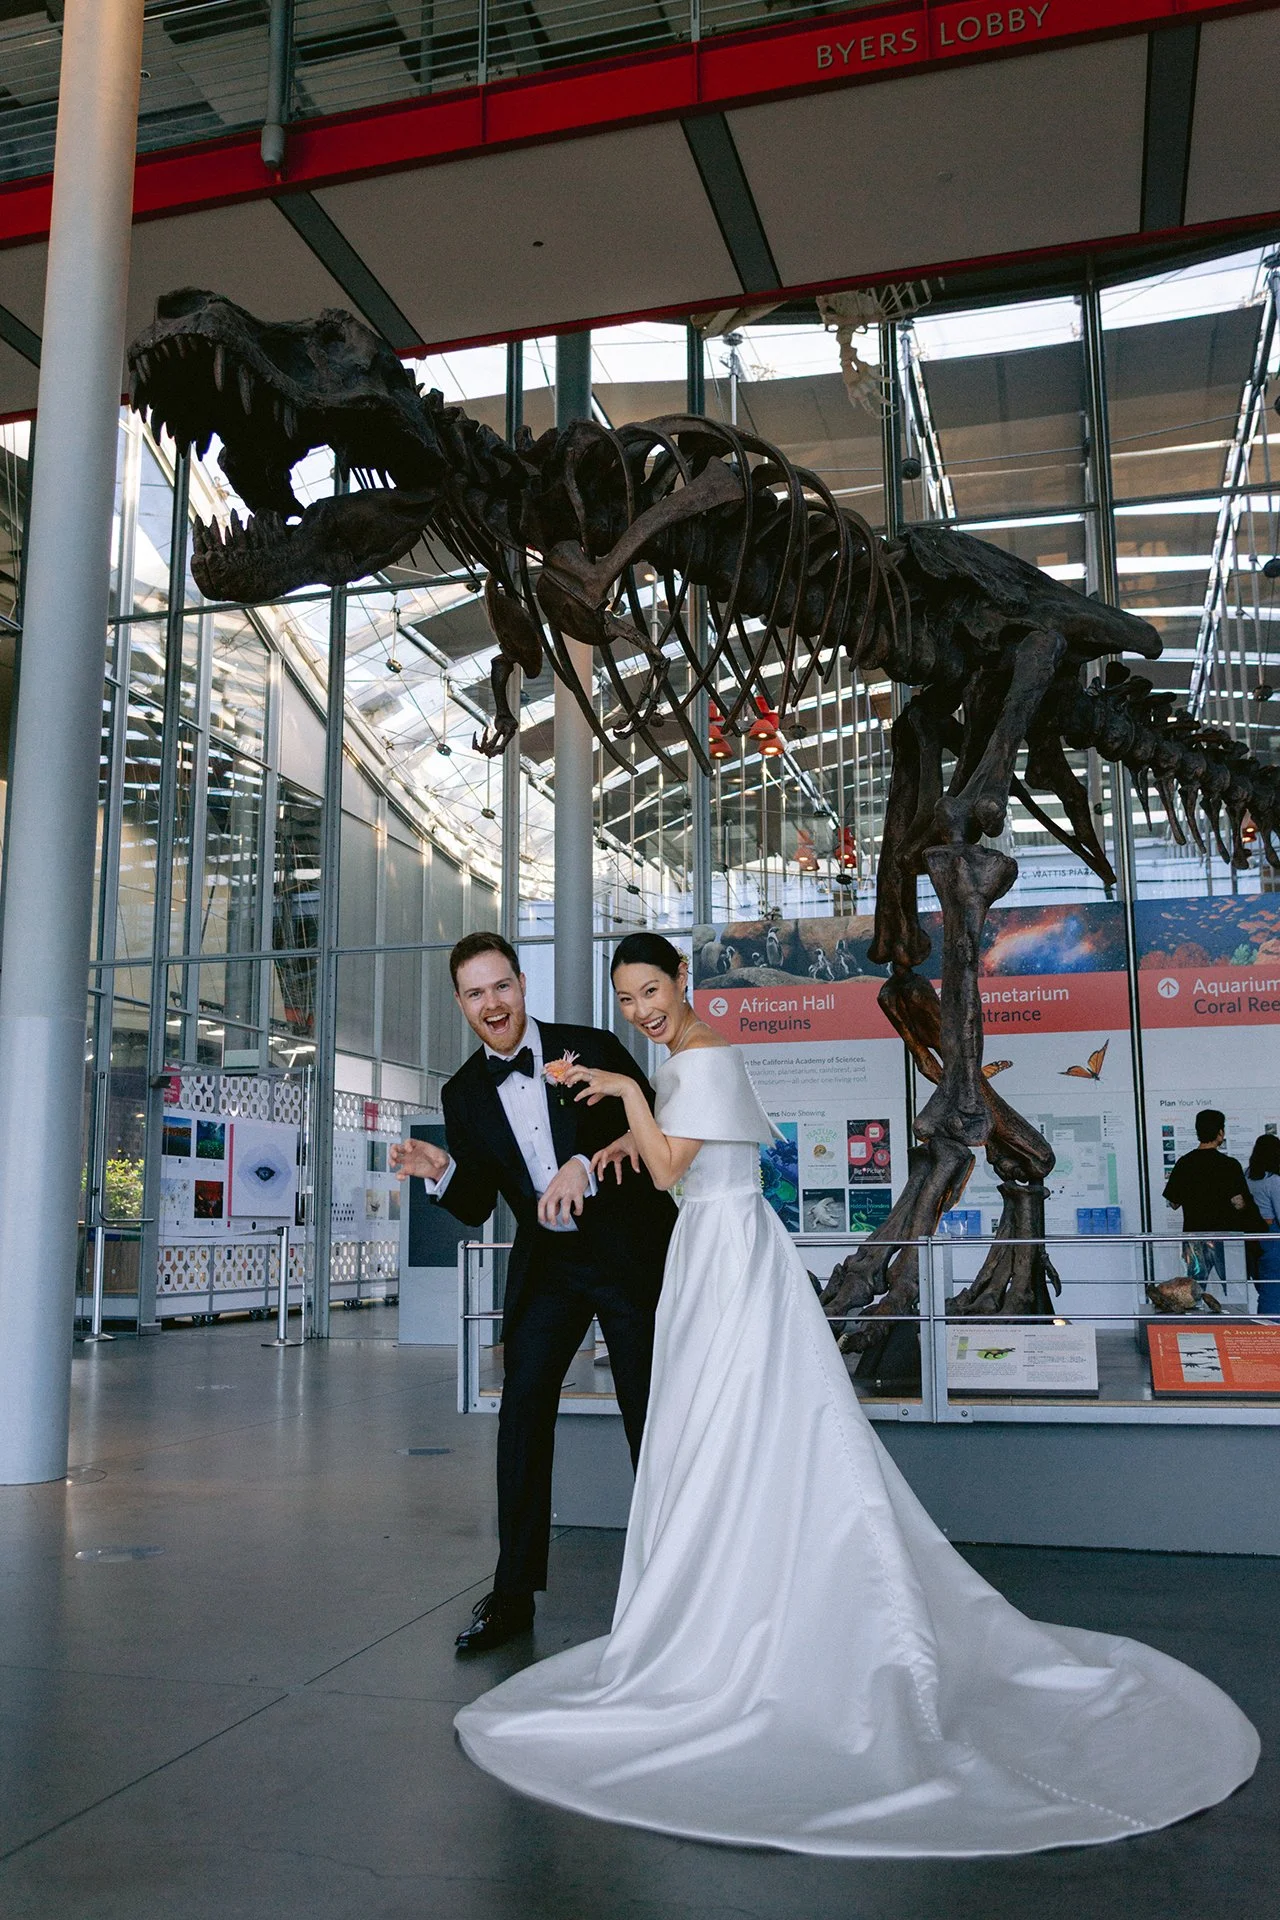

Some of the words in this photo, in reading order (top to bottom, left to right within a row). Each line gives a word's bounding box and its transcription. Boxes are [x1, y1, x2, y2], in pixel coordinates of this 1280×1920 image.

[816, 28, 918, 69] BYERS
[939, 3, 1050, 47] LOBBY
[1033, 869, 1067, 878] WATTIS
[1069, 866, 1096, 876] PIAZZ
[980, 986, 1069, 1004] anetarium
[1192, 977, 1280, 997] Aquarium
[739, 997, 798, 1014] African
[802, 993, 835, 1011] Hall
[1193, 997, 1241, 1015] Coral
[1248, 996, 1280, 1012] Ree
[982, 1008, 1041, 1023] ntrance
[739, 1016, 812, 1035] Penguins
[762, 1058, 794, 1066] California
[795, 1057, 826, 1065] Academy
[798, 1109, 826, 1117] Showing
